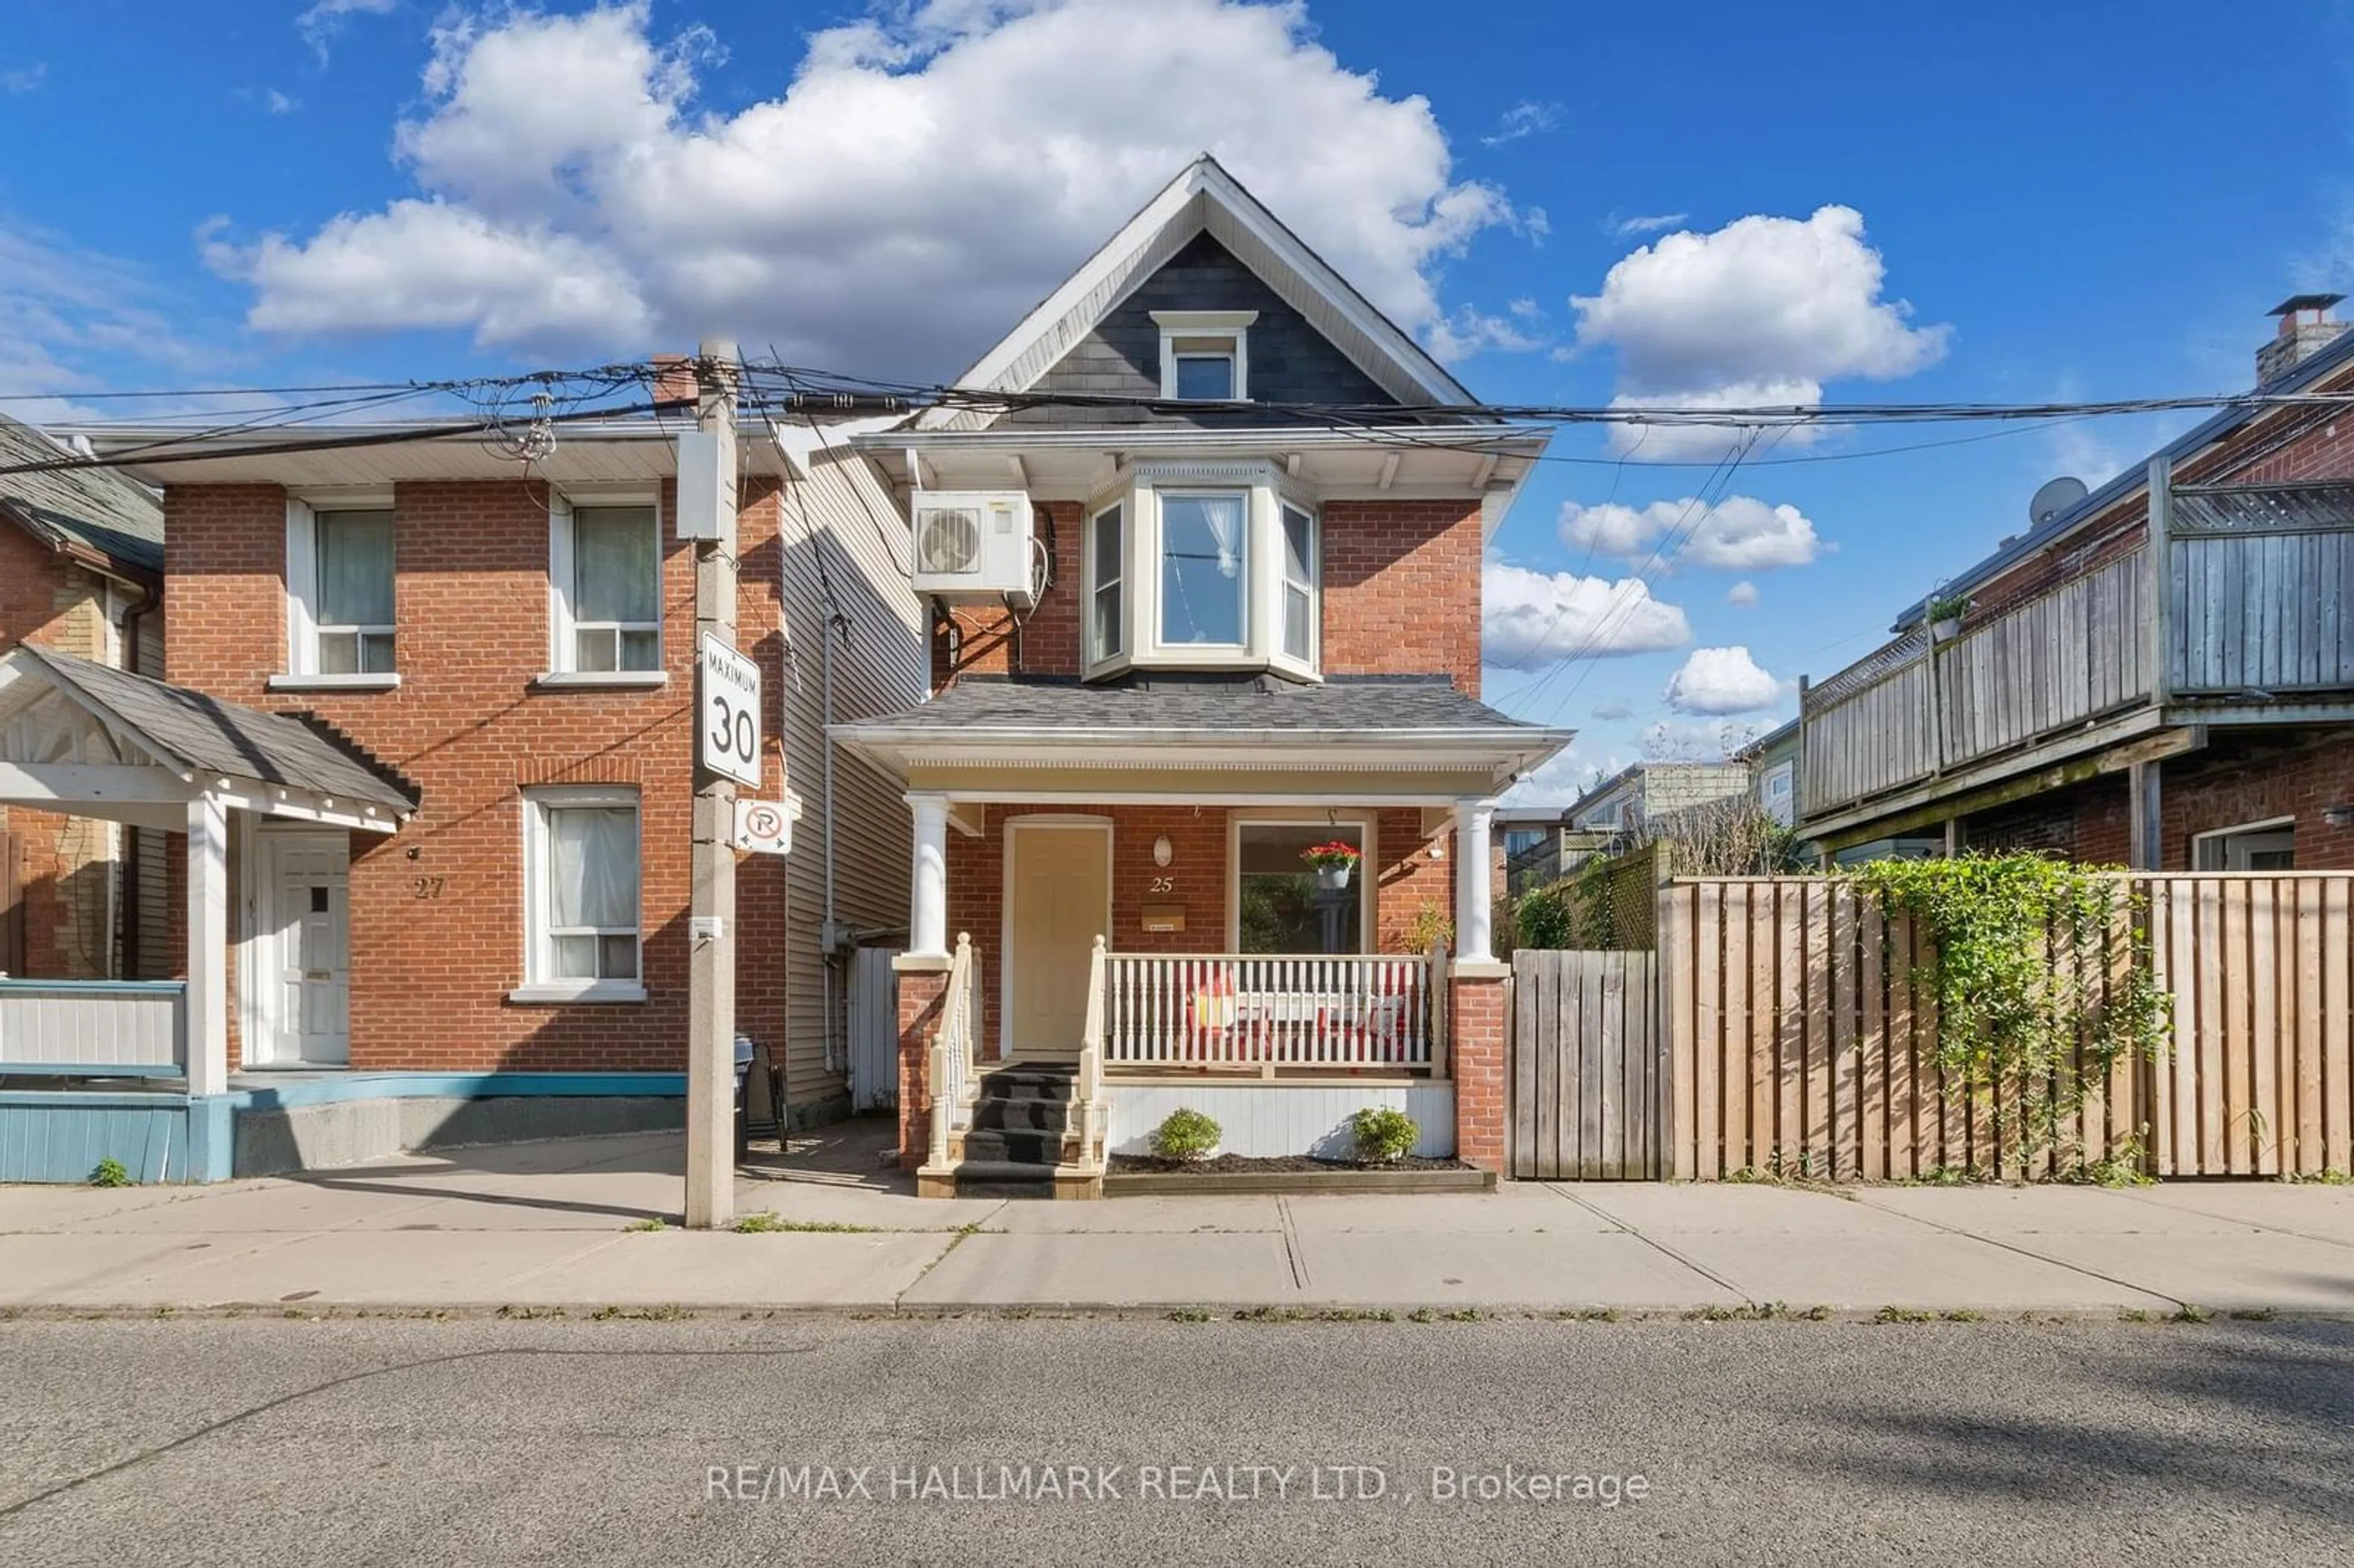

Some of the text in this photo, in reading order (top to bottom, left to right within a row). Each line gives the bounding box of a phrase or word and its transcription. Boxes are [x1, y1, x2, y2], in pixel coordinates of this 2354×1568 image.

[709, 650, 756, 696] MAXIMUM
[711, 696, 755, 764] 30
[414, 876, 447, 899] 27
[1149, 877, 1174, 893] 25
